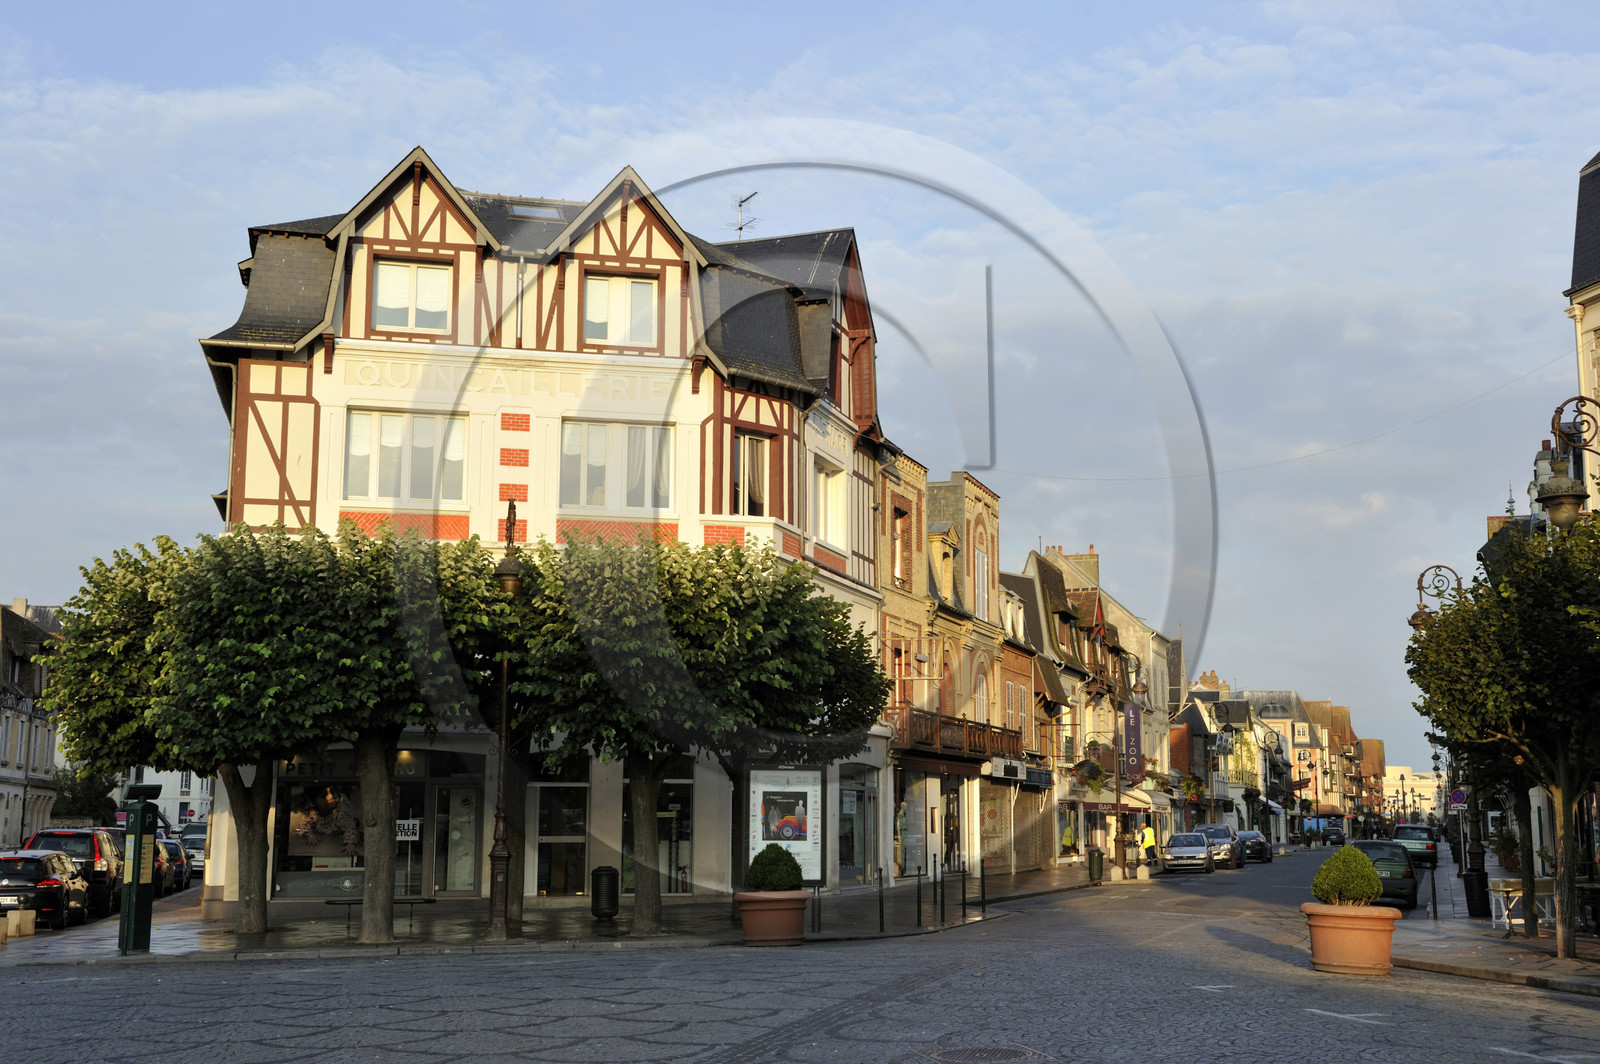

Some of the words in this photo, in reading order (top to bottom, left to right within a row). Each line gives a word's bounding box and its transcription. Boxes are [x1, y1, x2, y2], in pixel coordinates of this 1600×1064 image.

[354, 360, 673, 402] QUINCAILLERIE
[286, 762, 335, 775] PETIT
[396, 823, 417, 831] ELLE
